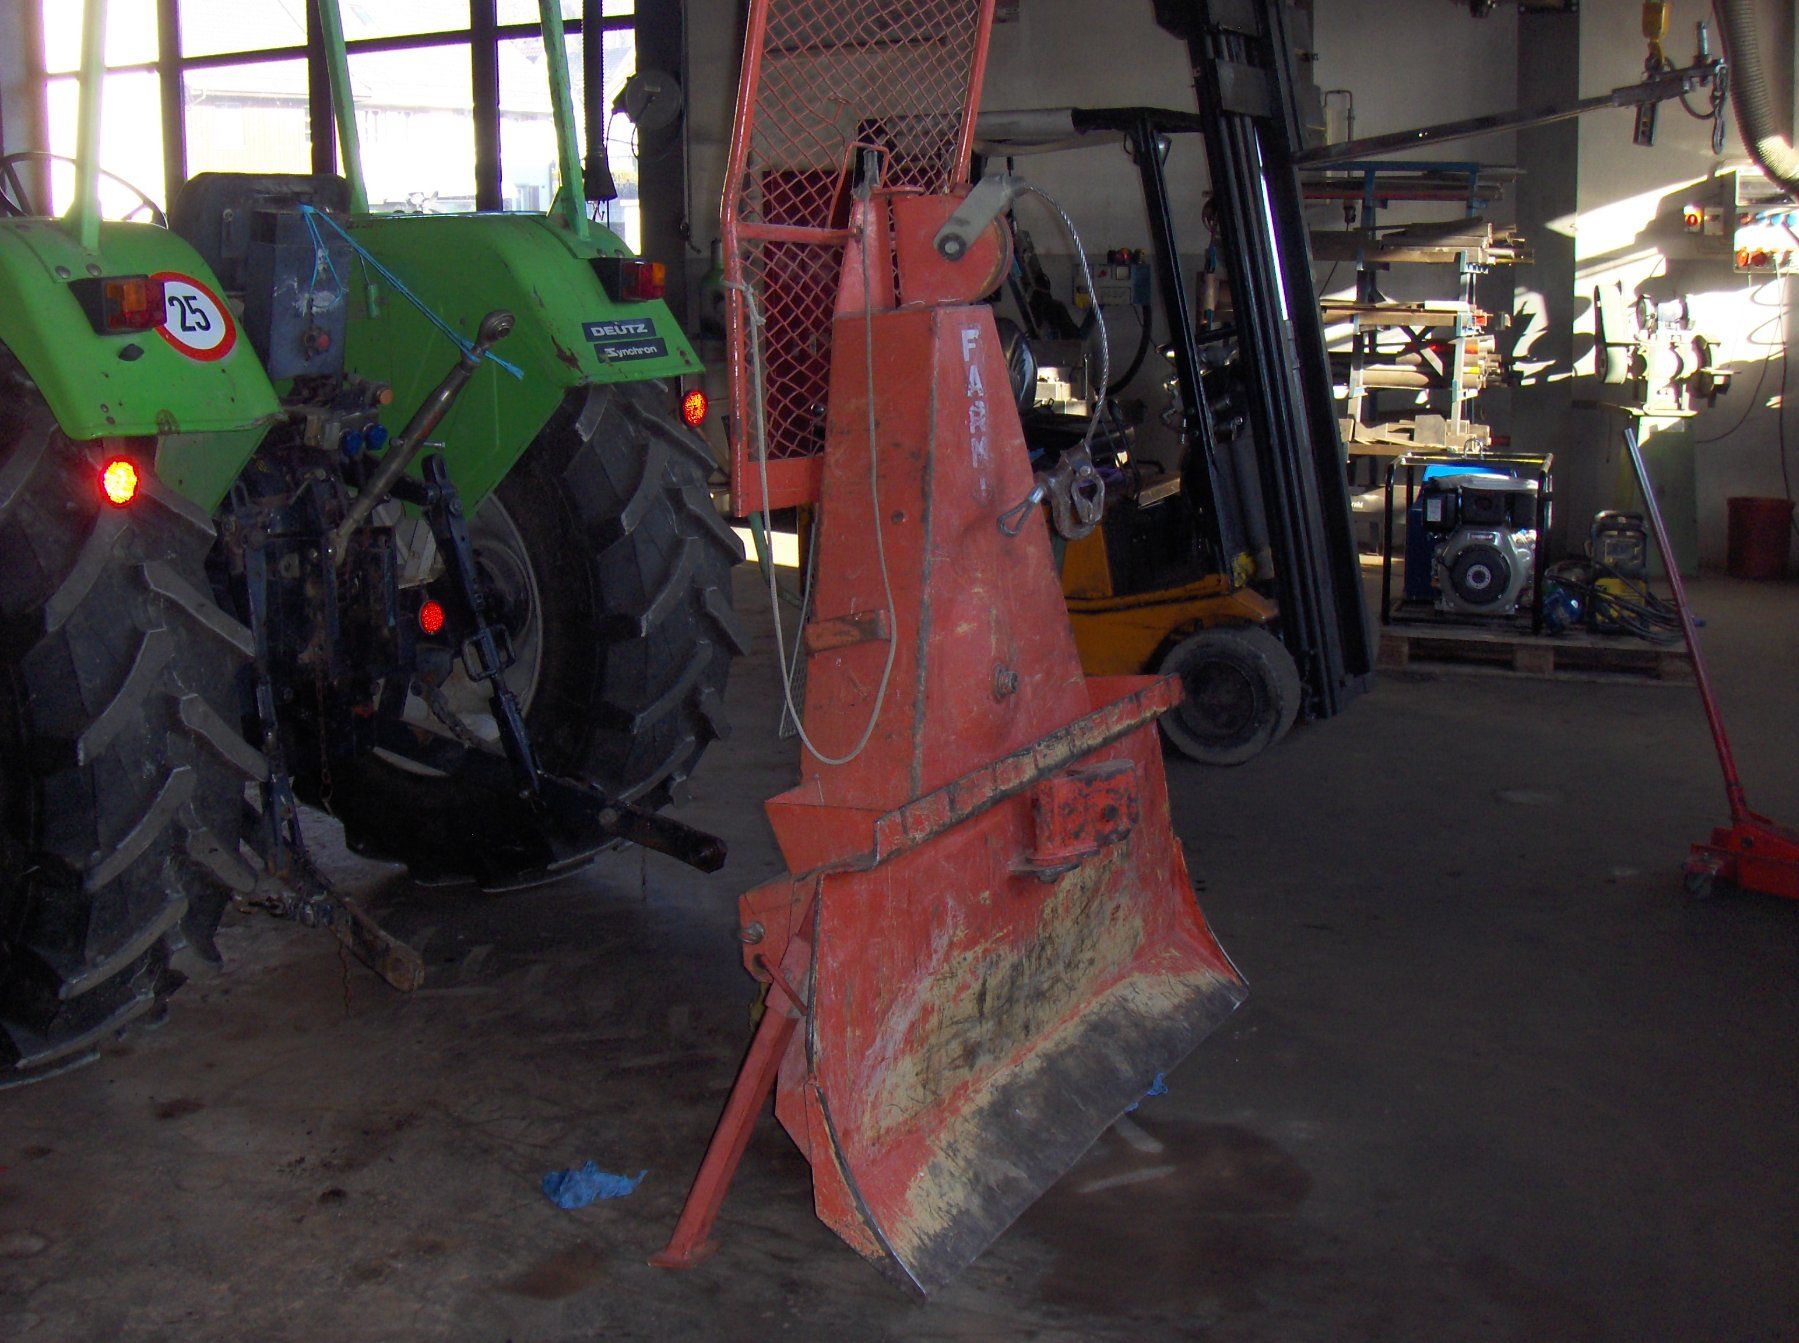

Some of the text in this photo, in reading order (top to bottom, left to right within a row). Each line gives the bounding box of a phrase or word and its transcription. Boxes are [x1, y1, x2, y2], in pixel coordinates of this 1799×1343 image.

[168, 295, 211, 332] 25
[590, 323, 648, 337] DEUTZ
[604, 346, 658, 358] Synchron
